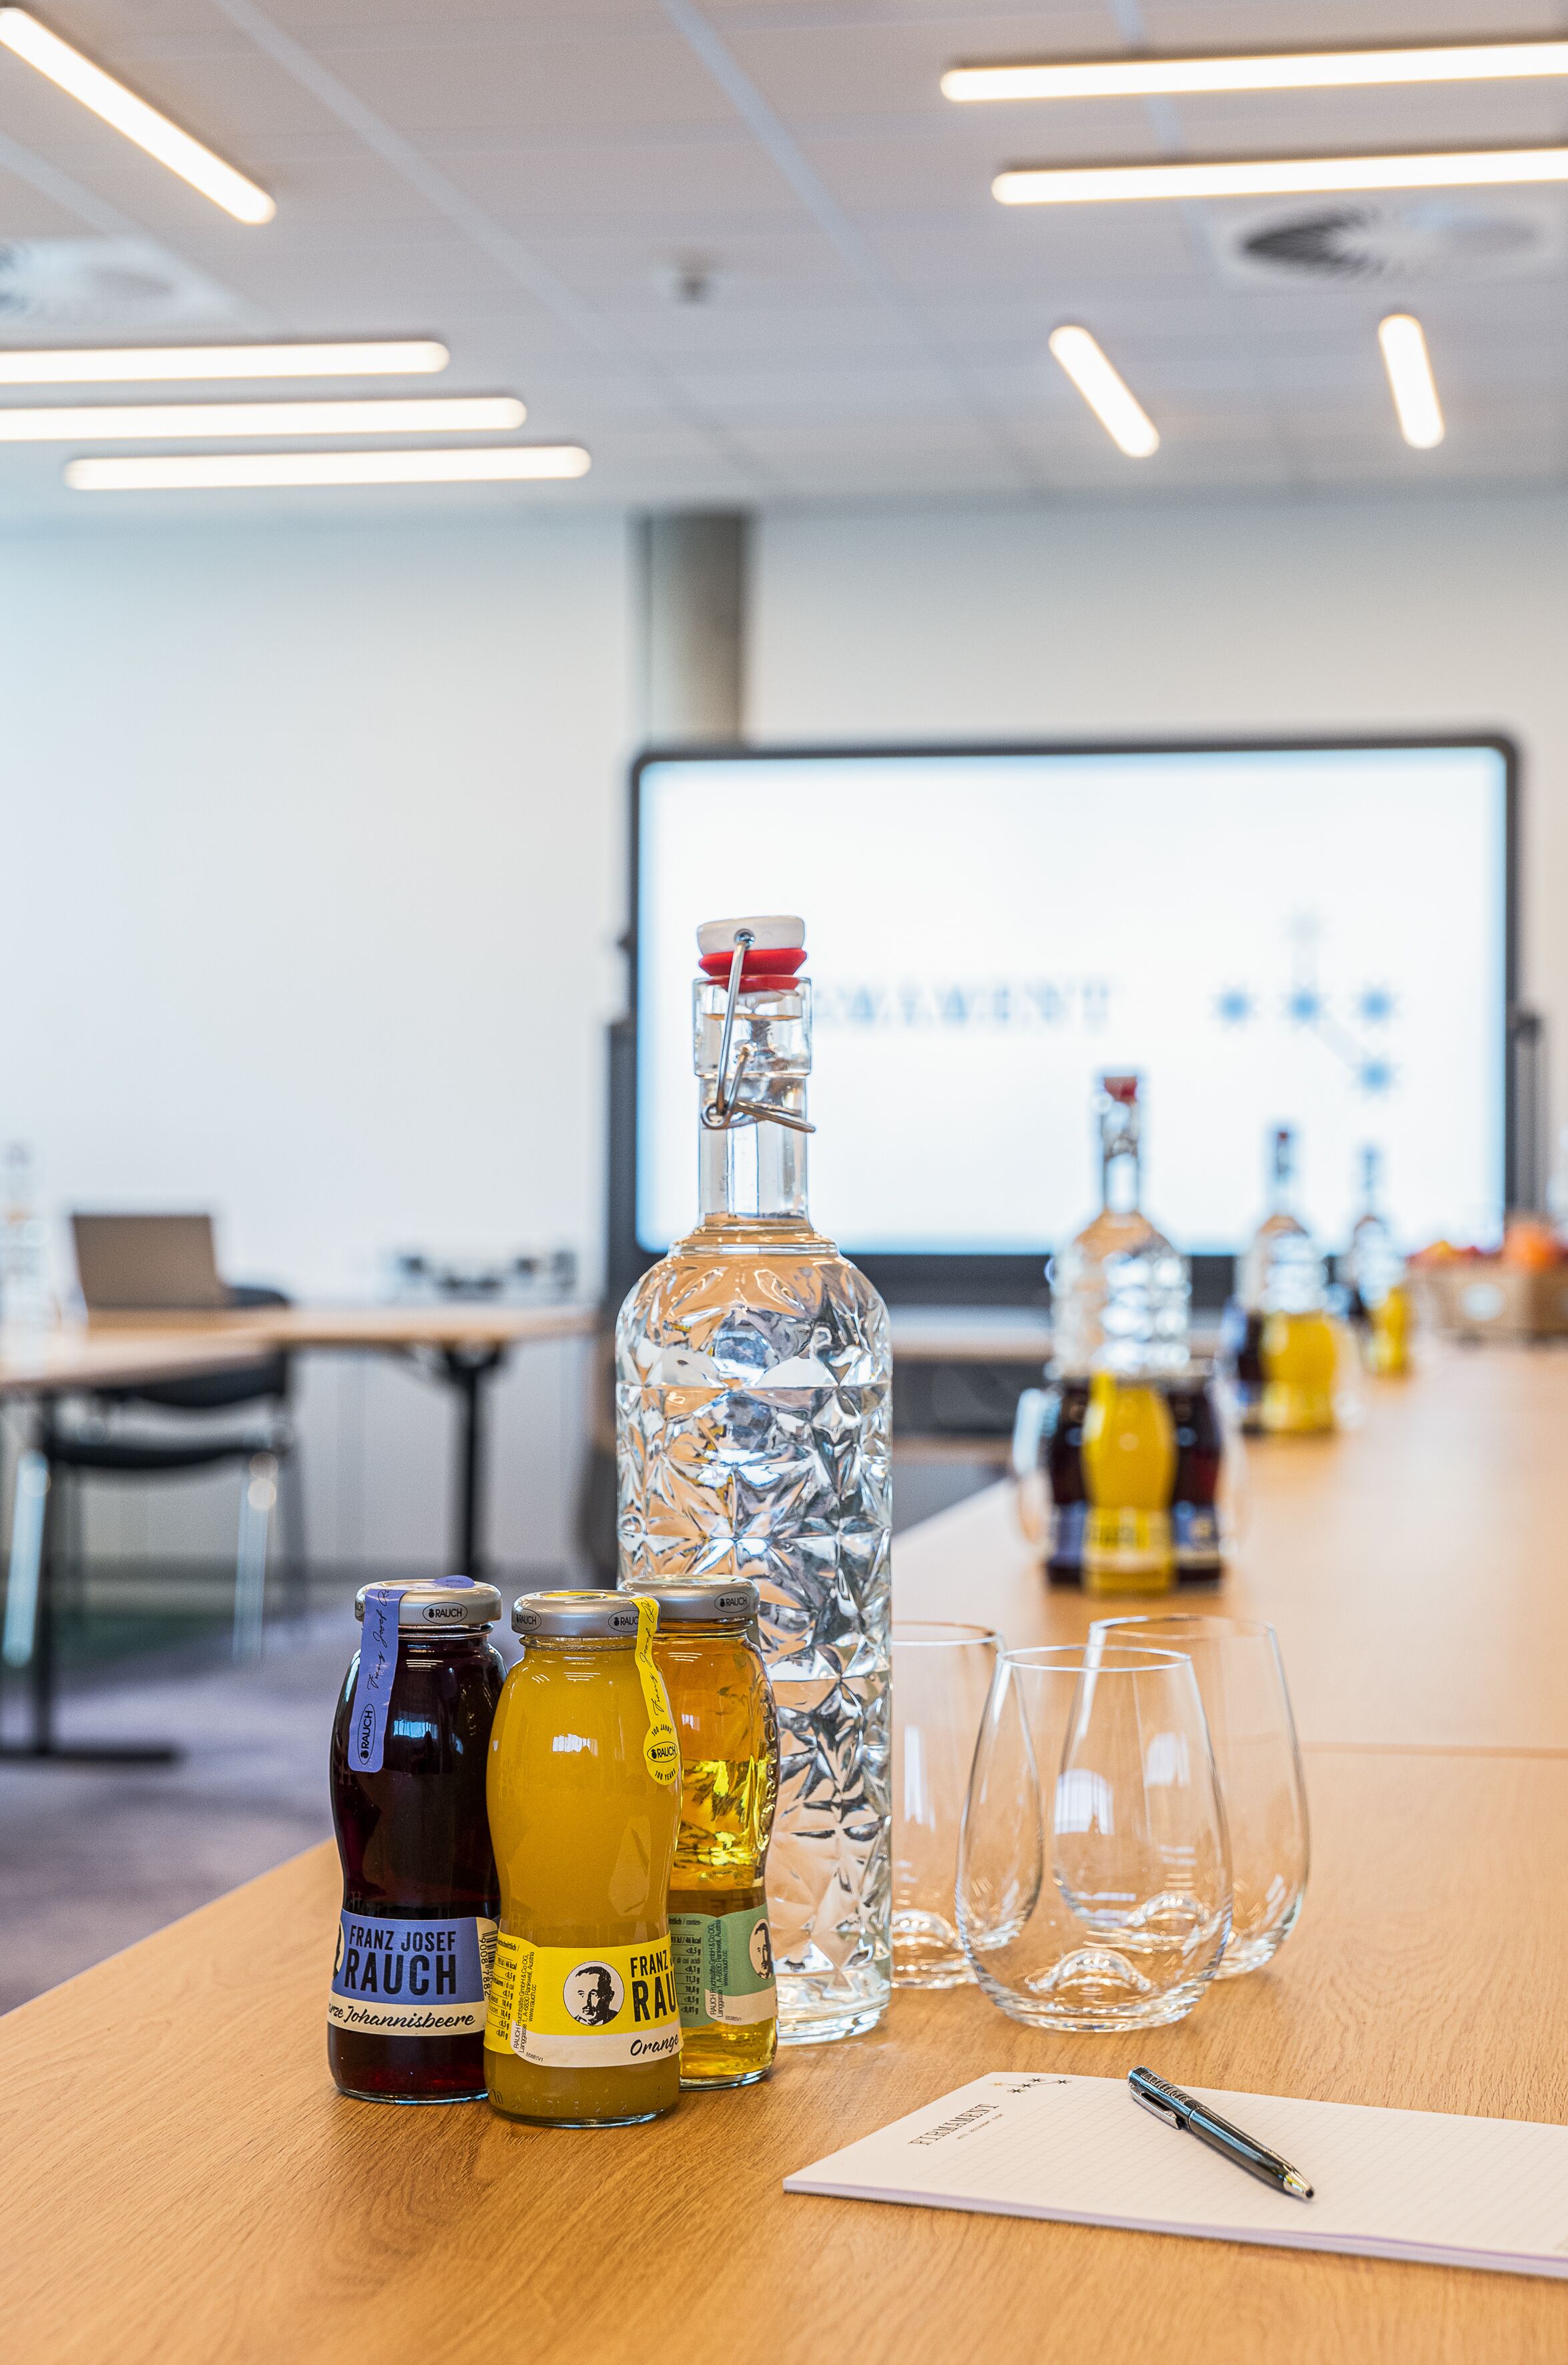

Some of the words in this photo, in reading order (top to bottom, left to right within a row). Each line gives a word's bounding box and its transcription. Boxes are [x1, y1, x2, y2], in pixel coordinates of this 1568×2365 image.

[726, 1596, 747, 1607] RAUCH
[435, 1608, 463, 1618] RAUCH
[519, 1615, 537, 1625] RAUCH
[620, 1616, 638, 1625] RAUC
[360, 1710, 373, 1749] RAUCH
[651, 1726, 660, 1736] 100
[660, 1724, 672, 1735] JAHRE
[657, 1746, 676, 1758] RAUCH
[655, 1770, 663, 1780] 100
[665, 1768, 676, 1781] YEARS
[348, 1924, 395, 1950] FRANZ
[401, 1931, 457, 1952] JOSEF
[708, 1934, 715, 1943] Co
[479, 1937, 489, 1964] 9008
[344, 1948, 457, 1996] RAUCH
[630, 1949, 668, 1978] FRANZ
[505, 1971, 513, 1980] <0,5
[515, 1997, 524, 2027] Fruchtsäfte
[521, 1964, 527, 1974] Co
[528, 1984, 537, 2022] www.rauch.cc
[632, 1970, 677, 2023] RAU
[343, 2005, 475, 2028] Johannisbeere
[519, 2024, 527, 2053] Langgasse
[525, 1970, 533, 1996] Rankweil,
[499, 2020, 507, 2028] <0,5
[630, 2034, 678, 2056] Orange
[908, 2103, 999, 2145] FIRMAMENT
